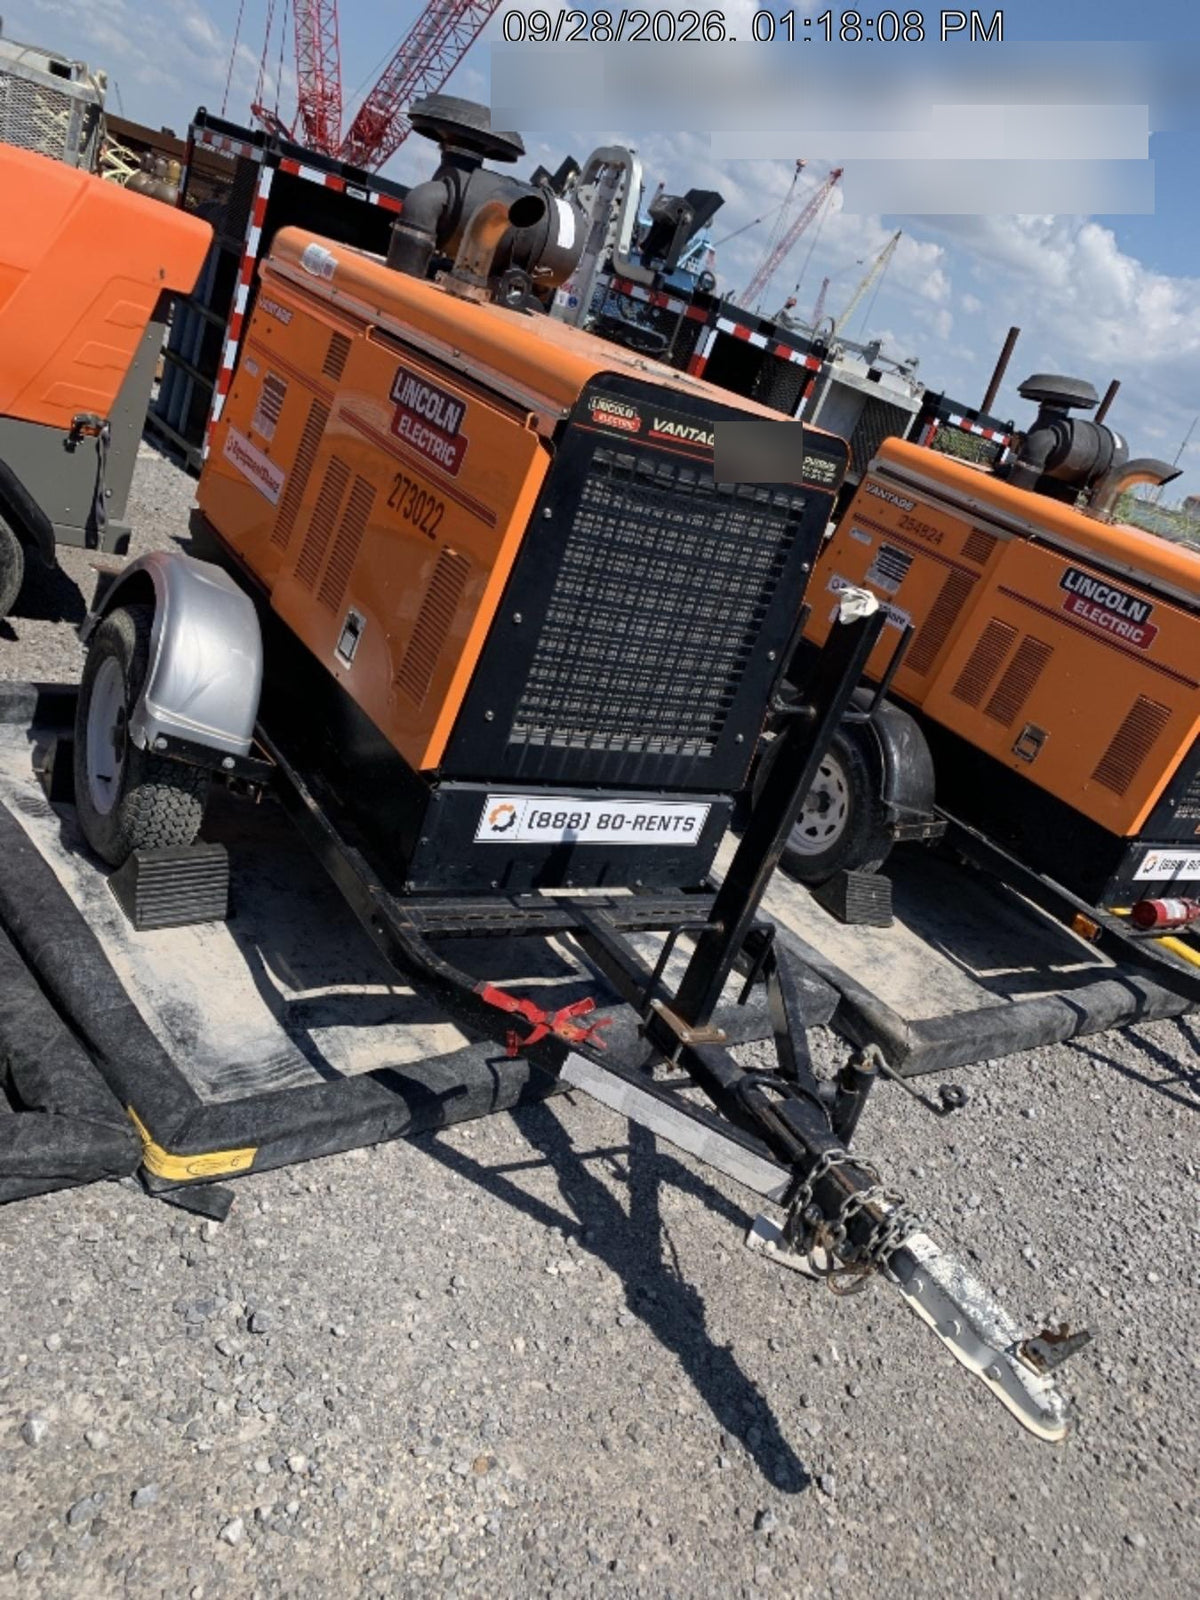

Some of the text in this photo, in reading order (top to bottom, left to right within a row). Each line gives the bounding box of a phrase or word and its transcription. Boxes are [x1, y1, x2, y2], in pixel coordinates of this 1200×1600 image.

[392, 372, 461, 434] LINCOLN
[398, 415, 456, 467] ELECTRIC
[387, 472, 445, 540] 273022
[865, 482, 917, 512] VANTAGE
[1064, 571, 1147, 622] LINCOLN
[1073, 599, 1145, 643] ELECTRIC
[527, 809, 697, 833] (888) 80-RENTS
